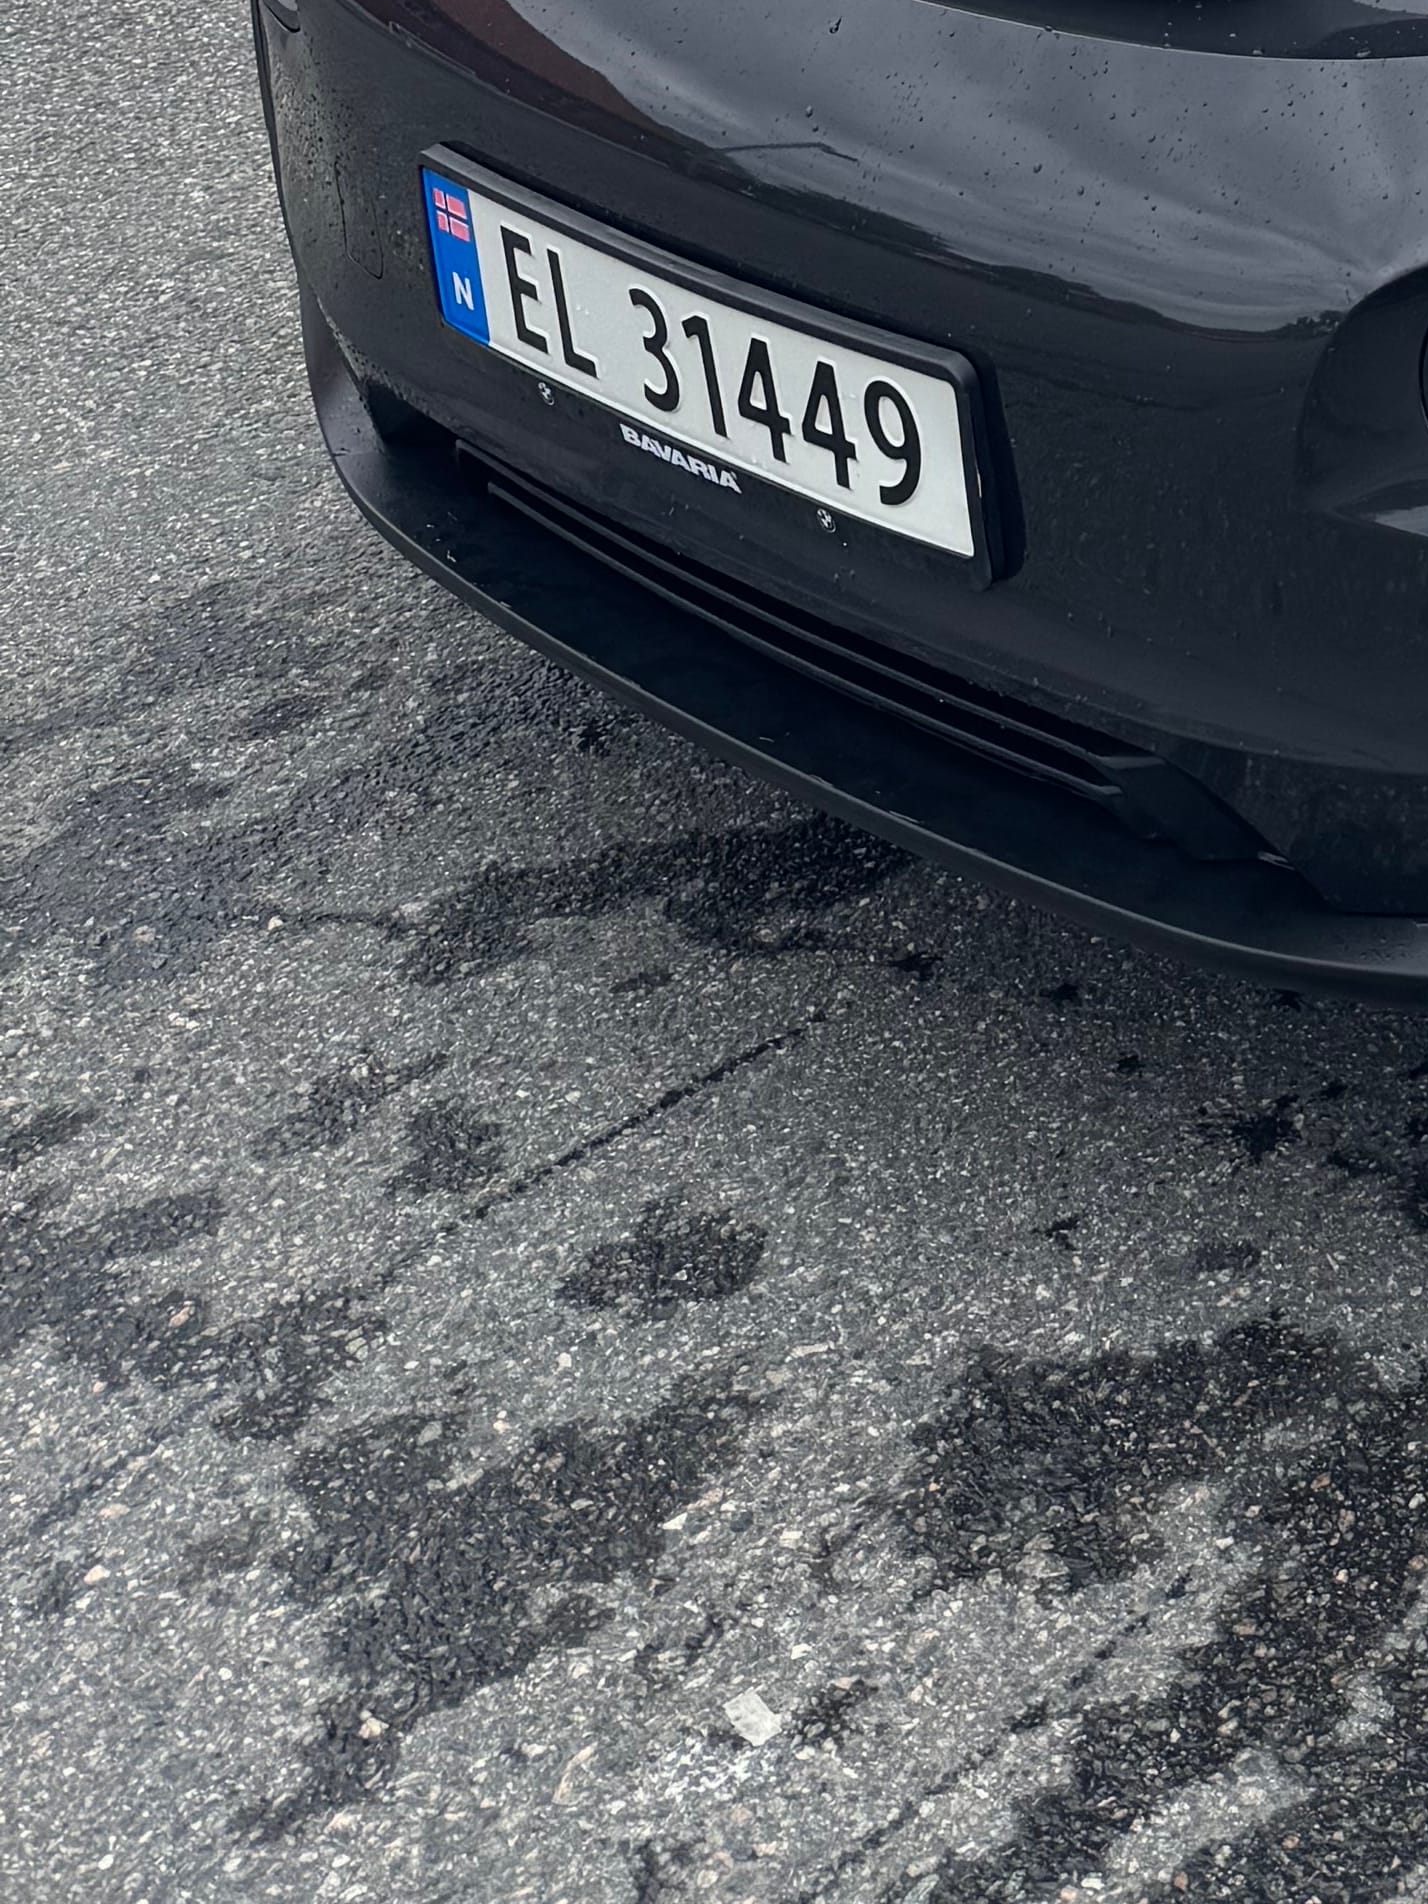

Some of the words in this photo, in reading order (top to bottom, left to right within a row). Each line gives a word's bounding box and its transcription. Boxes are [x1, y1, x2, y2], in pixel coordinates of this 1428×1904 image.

[452, 271, 475, 311] N
[500, 225, 597, 379] EL
[628, 288, 923, 506] 31449
[619, 423, 743, 495] BAVARIA
